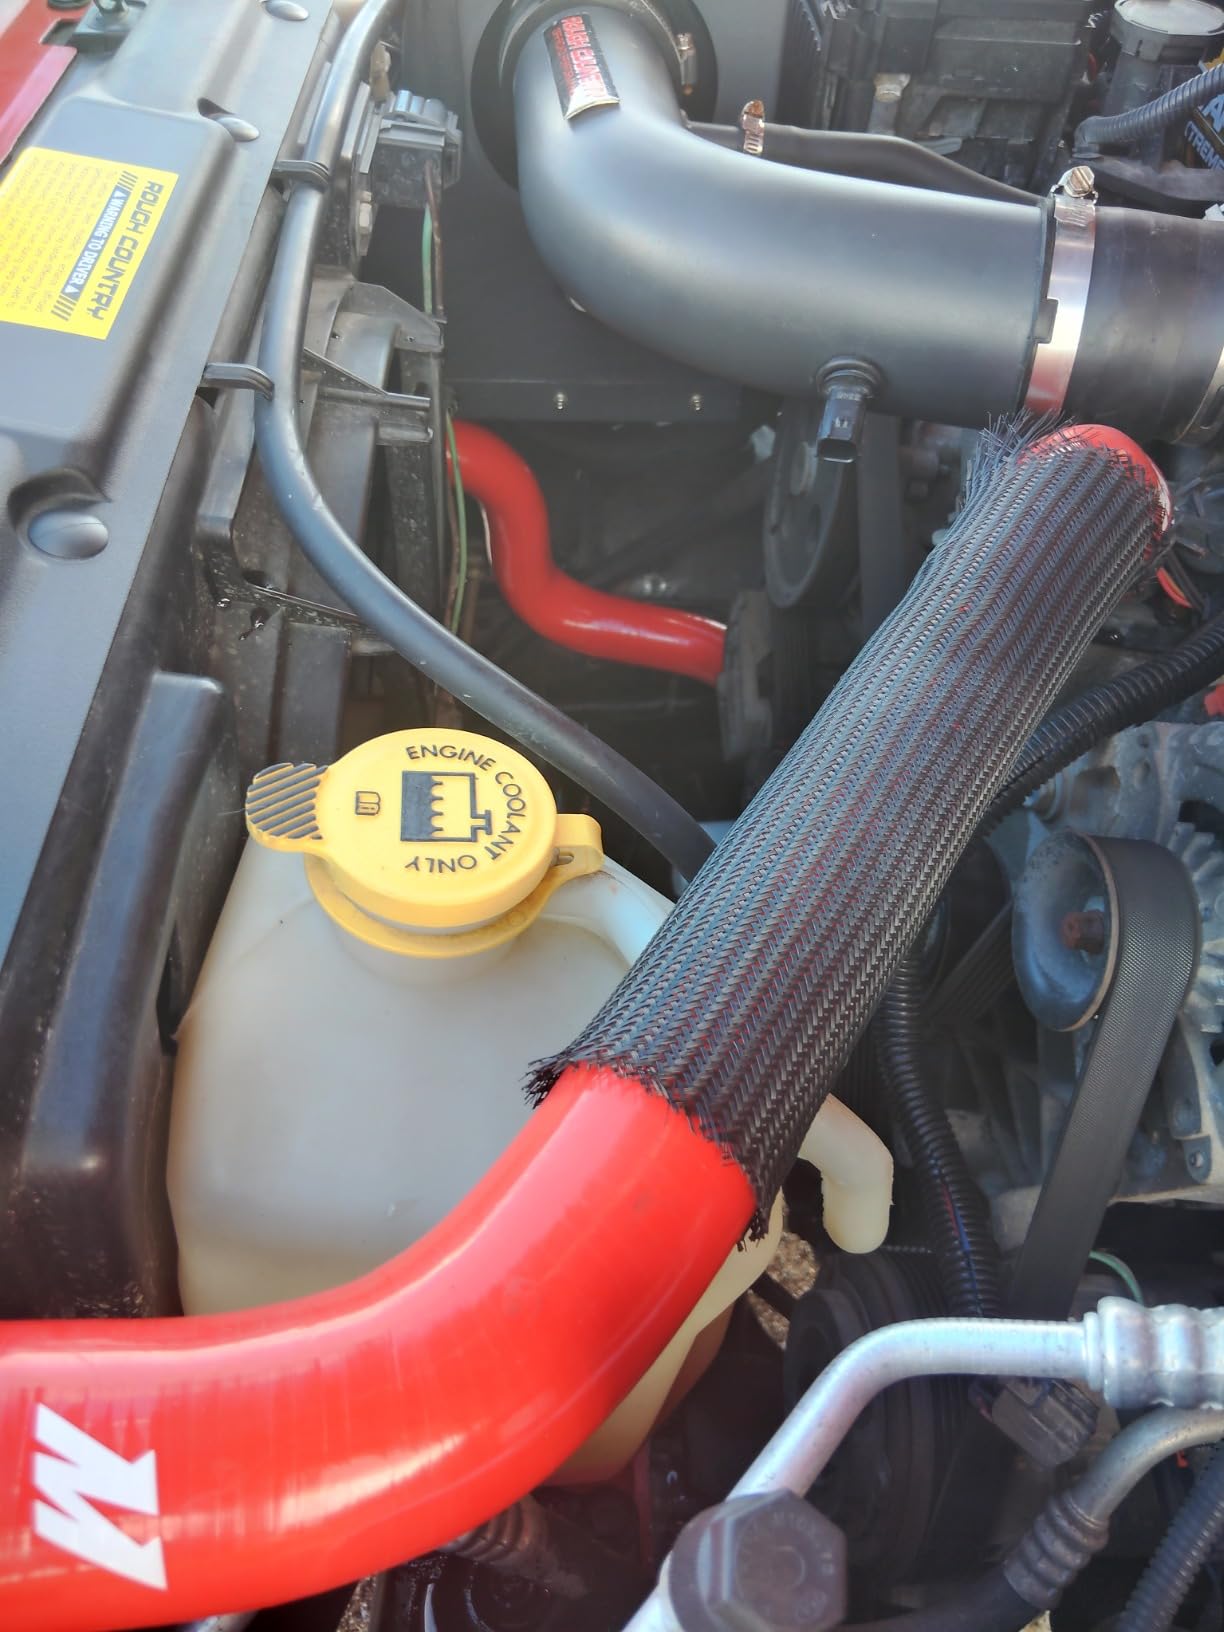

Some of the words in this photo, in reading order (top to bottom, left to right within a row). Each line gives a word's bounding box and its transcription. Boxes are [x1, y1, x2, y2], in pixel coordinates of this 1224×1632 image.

[95, 198, 126, 241] WARNING
[126, 181, 164, 235] ROUGH
[88, 240, 104, 250] TO
[71, 250, 98, 286] DRIVER
[87, 235, 139, 320] COUNTRY
[406, 745, 496, 771] ENGINE
[485, 772, 526, 860] COOLANT
[405, 855, 477, 873] ONLY
